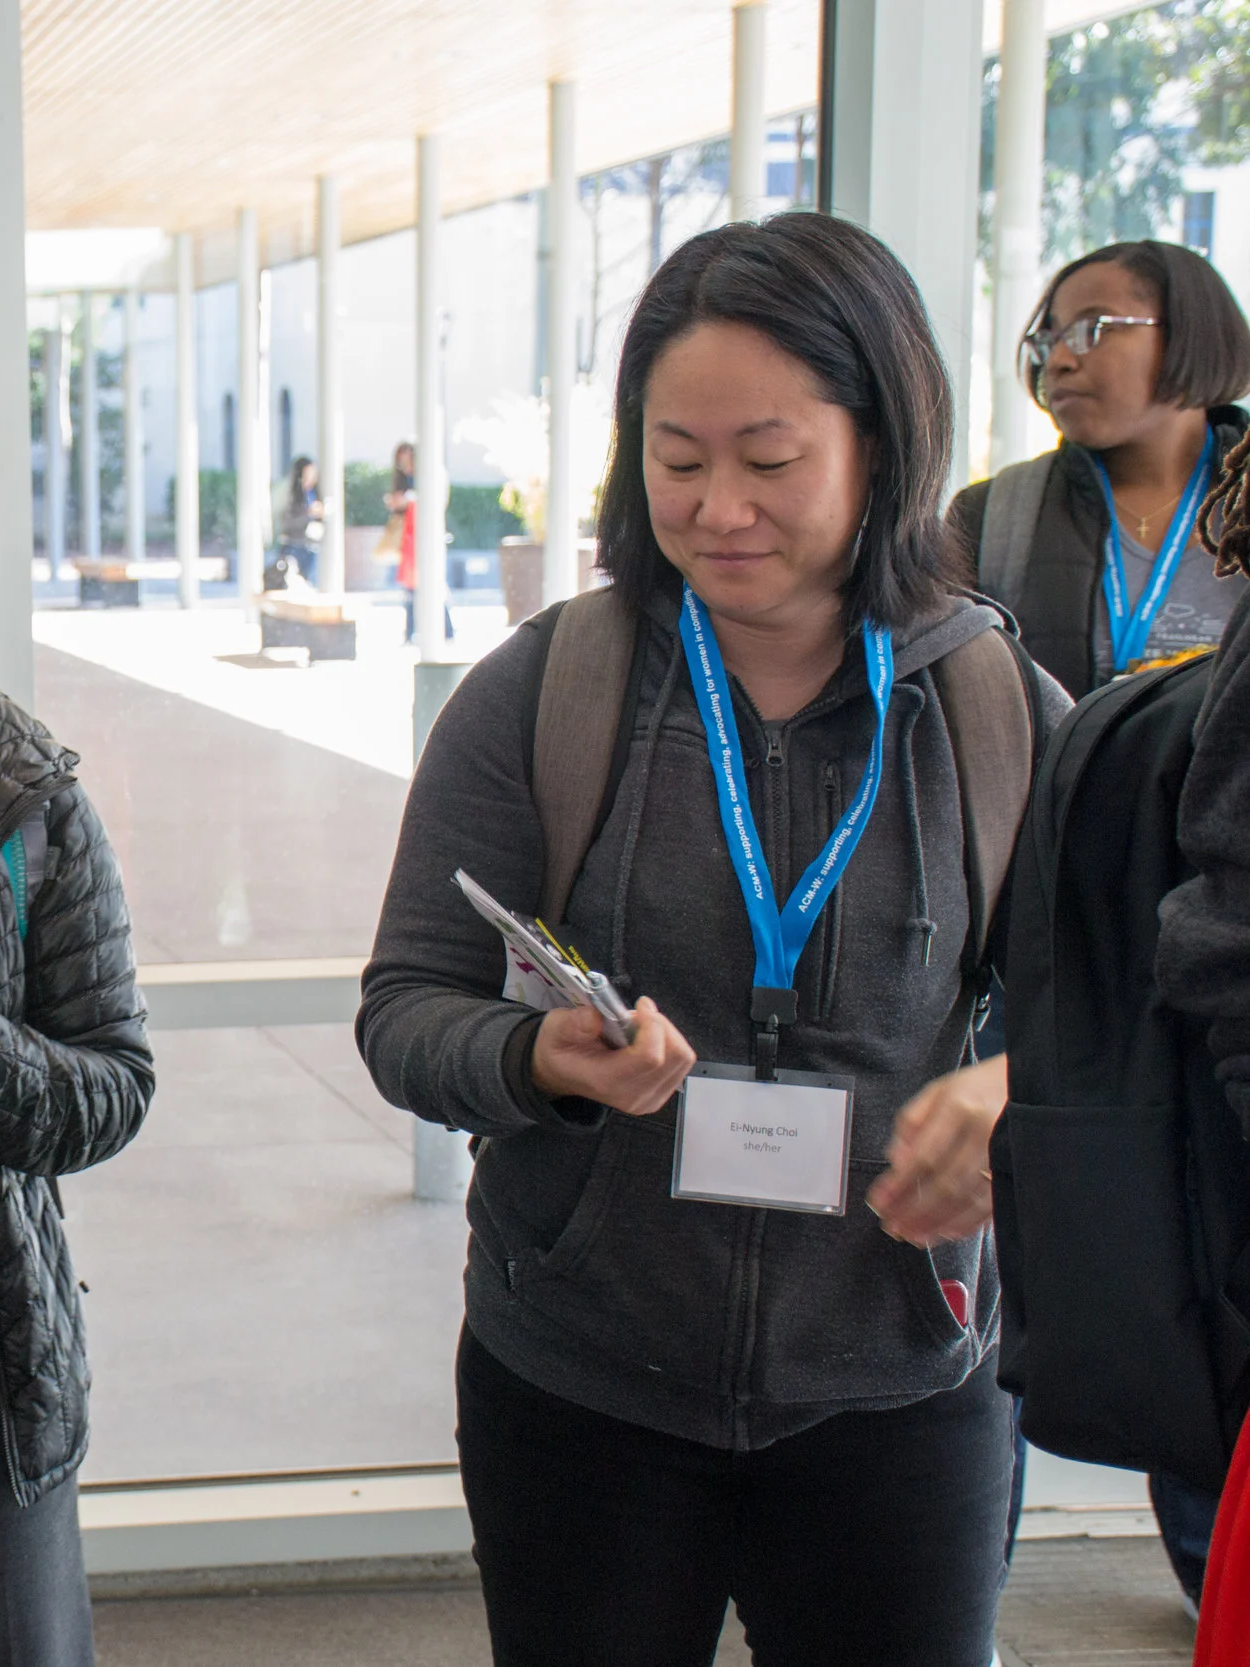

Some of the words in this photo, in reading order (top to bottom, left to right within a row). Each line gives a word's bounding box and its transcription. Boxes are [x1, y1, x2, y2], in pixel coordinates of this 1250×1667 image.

[695, 633, 704, 643] in
[698, 643, 712, 677] women
[706, 679, 716, 693] for
[710, 693, 729, 745] advocating
[722, 746, 738, 802] celebrating,
[733, 804, 753, 859] supporting,
[746, 861, 764, 900] ACM-W:
[798, 876, 825, 913] ACM-W:
[820, 826, 853, 877] supporting,
[730, 1121, 773, 1137] Ei-Nyung
[776, 1126, 798, 1137] Choi
[743, 1141, 782, 1153] she/her
